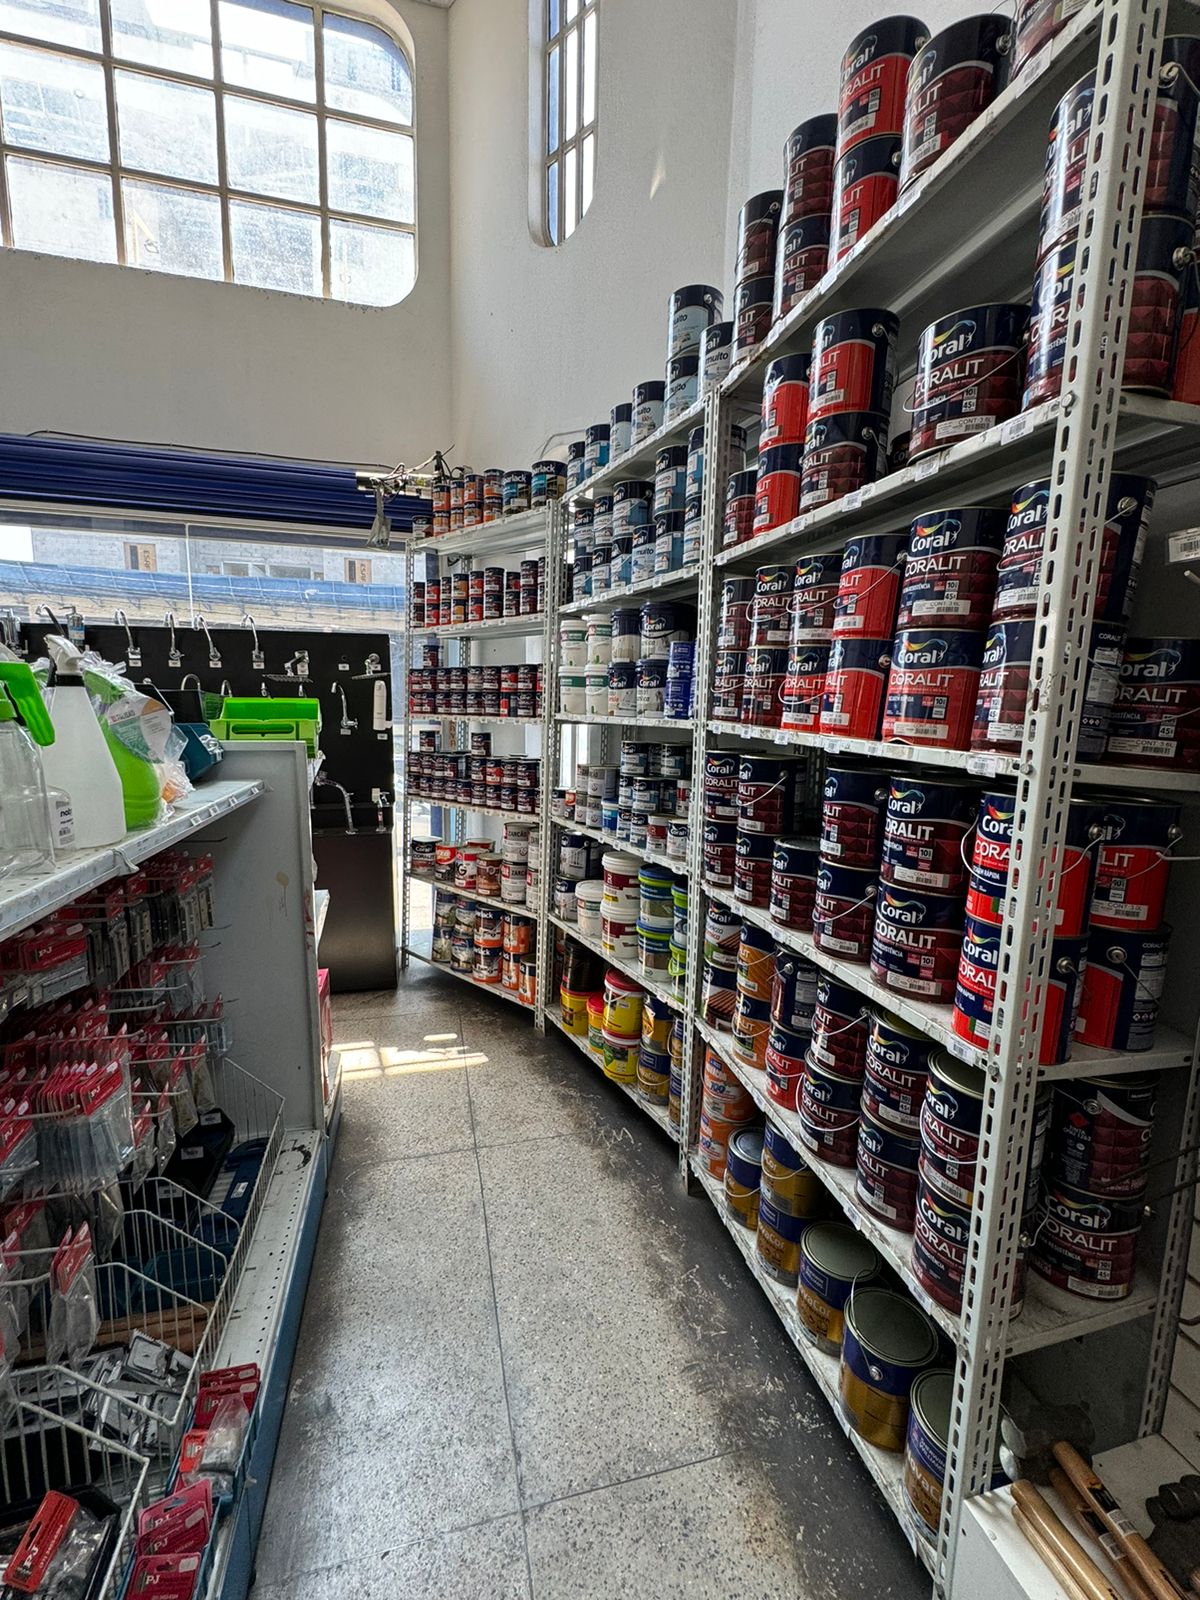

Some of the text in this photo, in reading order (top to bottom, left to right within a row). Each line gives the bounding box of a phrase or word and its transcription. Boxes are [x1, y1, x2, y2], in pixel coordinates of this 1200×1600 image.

[911, 83, 943, 116] ALIT
[783, 254, 809, 272] ALIT
[914, 358, 985, 397] CORALIT
[911, 531, 950, 553] Coral
[1002, 532, 1045, 558] ORALI
[904, 556, 967, 577] CORALIT
[756, 581, 783, 592] Coral
[897, 651, 937, 664] Coral
[889, 672, 955, 687] CORALIT
[706, 763, 730, 774] Coral
[888, 794, 917, 815] Coral
[974, 839, 1012, 861] CORA
[881, 900, 917, 924] Coral
[875, 918, 937, 950] CORALIT
[963, 936, 998, 965] Coral
[920, 1197, 963, 1241] Coral
[915, 1213, 967, 1265] CORALI
[145, 1574, 161, 1585] PJ
